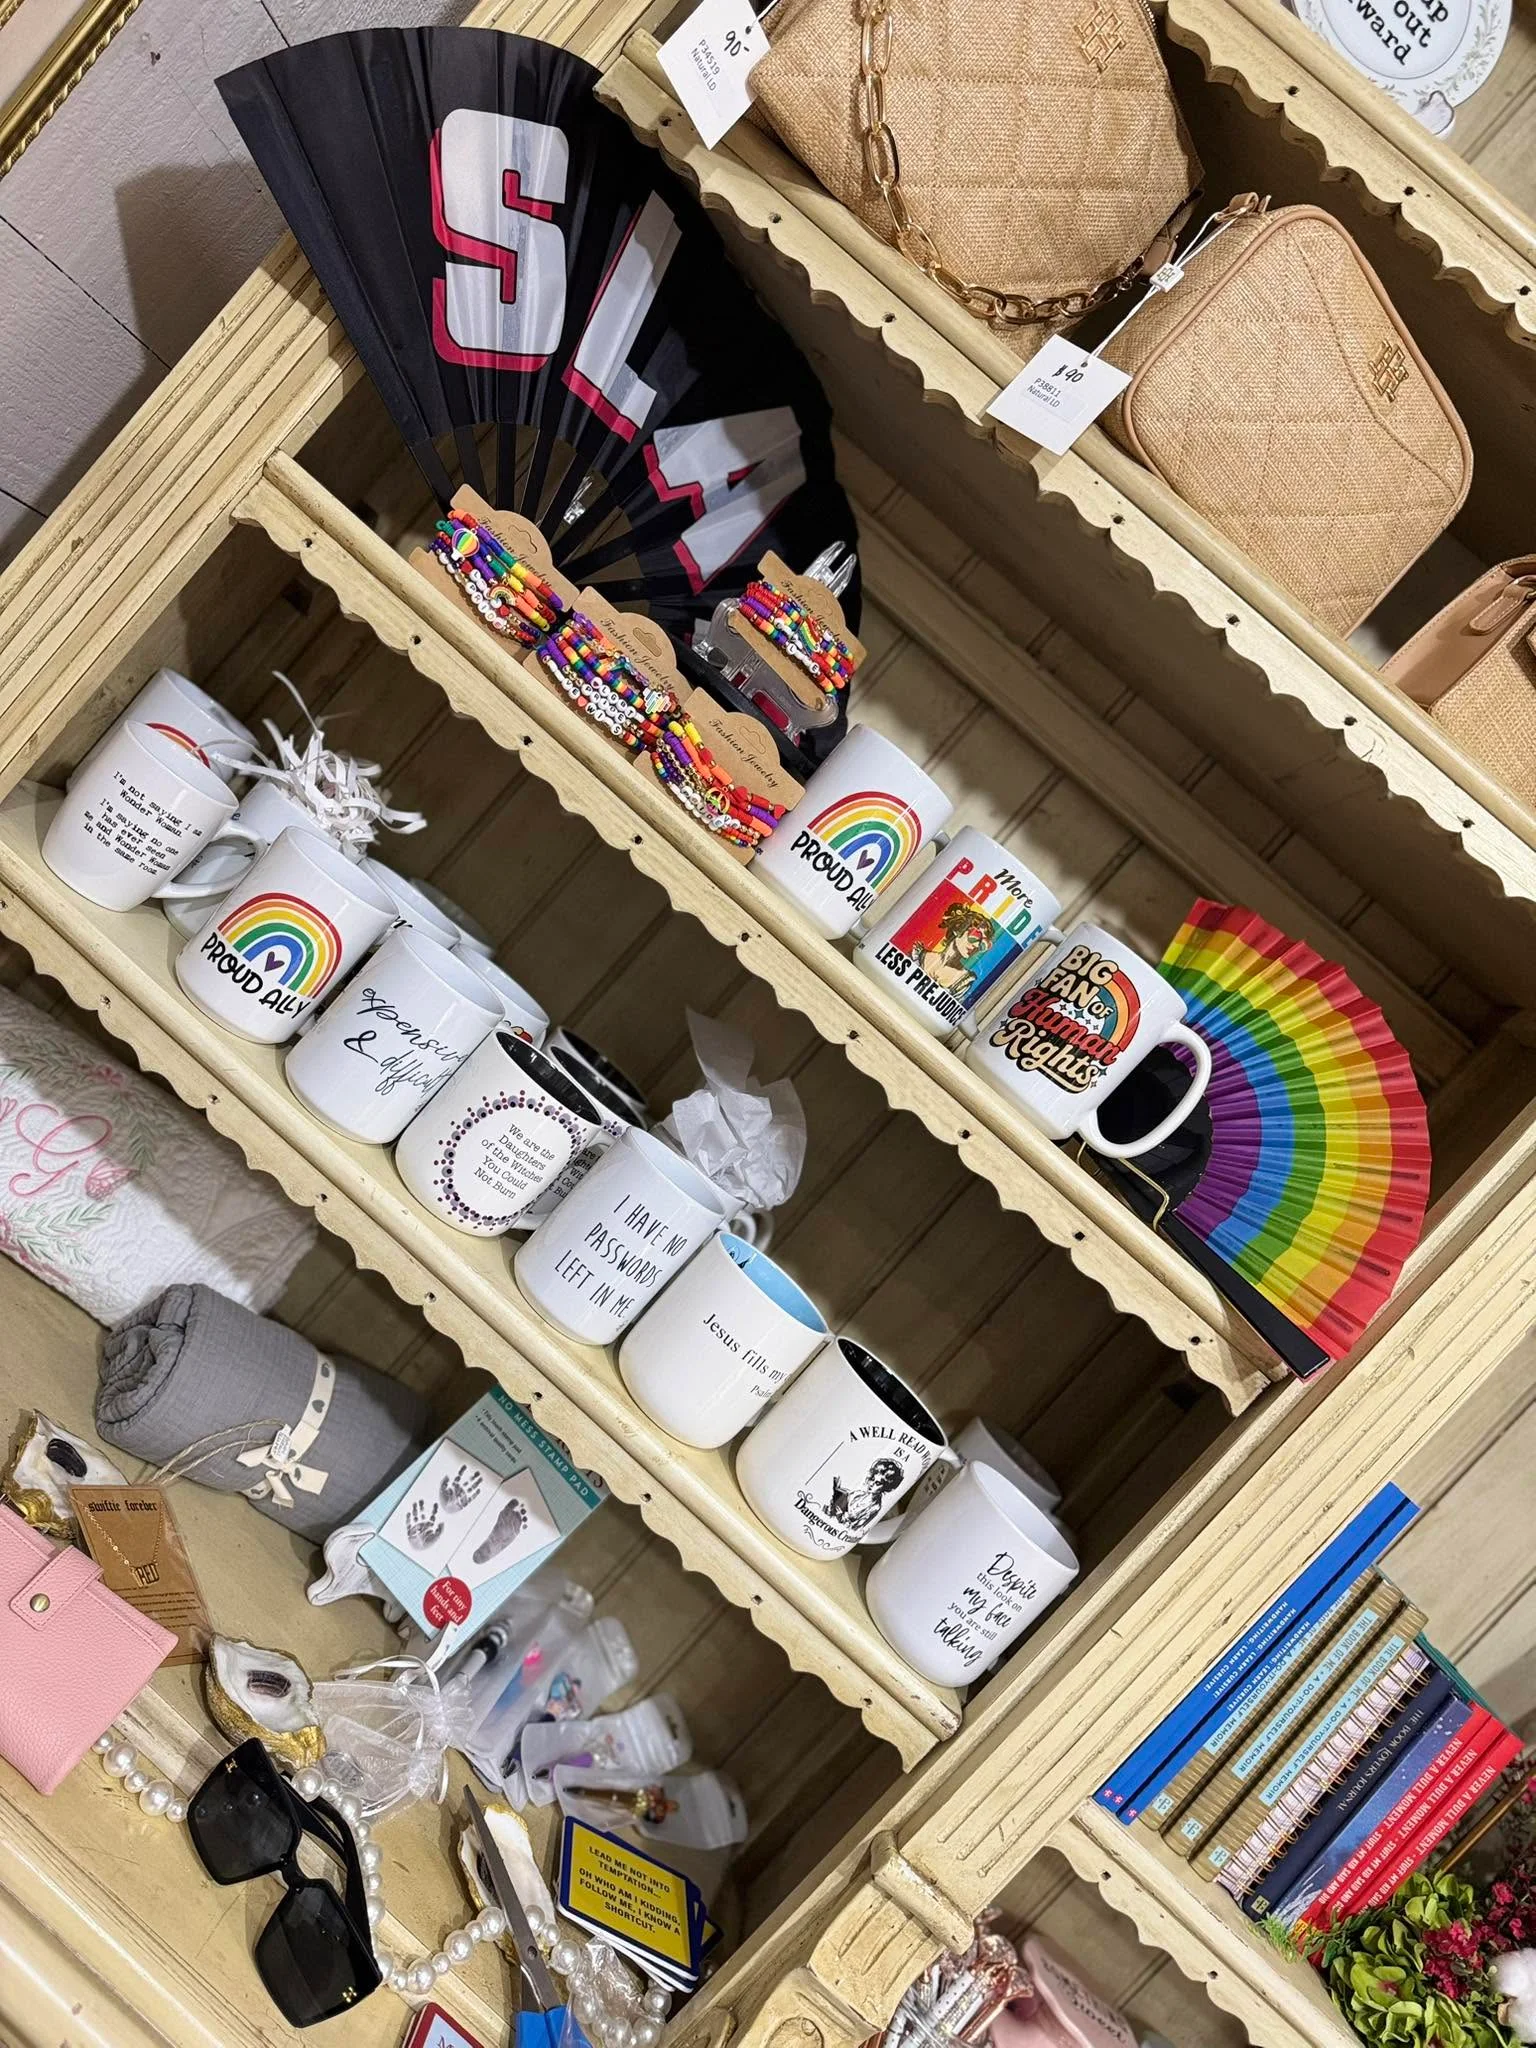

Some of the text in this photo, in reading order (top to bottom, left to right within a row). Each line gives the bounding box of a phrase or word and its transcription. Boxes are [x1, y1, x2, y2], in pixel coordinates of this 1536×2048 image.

[1351, 0, 1412, 66] ward
[1393, 1, 1431, 48] out
[691, 47, 717, 91] Natural LD
[699, 39, 720, 75] P34519
[428, 108, 806, 595] SLA
[1027, 385, 1060, 408] Natural LD
[1034, 377, 1062, 397] P38811
[477, 515, 516, 556] Fashion
[781, 580, 814, 616] Fashion
[600, 616, 675, 690] Fashion Jewelry
[708, 719, 778, 788] Fashion Jewelry
[100, 798, 150, 839] I'm saying
[113, 771, 183, 827] I'm not saying
[119, 789, 154, 817] Wonder
[84, 822, 136, 864] in the same
[96, 820, 147, 858] and Wonder
[101, 812, 166, 860] has ever seen
[790, 829, 853, 894] PROUD
[945, 856, 1042, 950] PRIDE
[995, 867, 1033, 909] More
[200, 931, 311, 1019] PROUD ALLY
[875, 941, 968, 1027] LESS PREJUDICE
[1061, 944, 1118, 986] BIG
[1041, 969, 1101, 1010] FAN
[1008, 988, 1118, 1066] Human
[343, 1030, 379, 1064] &
[989, 1021, 1101, 1095] Rights
[481, 1137, 544, 1184] of the Witches
[498, 1134, 547, 1171] Daughters
[508, 1123, 556, 1161] We are the
[473, 1166, 518, 1200] Not Burn
[481, 1154, 529, 1191] You Could
[612, 1194, 687, 1258] I HAVE NO
[584, 1222, 664, 1289] PASSWORDS
[554, 1249, 596, 1290] LEFT
[589, 1281, 611, 1308] IN
[702, 1313, 770, 1376] Jesus fills
[498, 1394, 513, 1411] NO
[512, 1409, 538, 1438] MESS
[538, 1436, 570, 1474] STAMP
[566, 1471, 591, 1498] PAD
[848, 1425, 927, 1459] A WELL READ
[88, 1500, 121, 1512] swiftie
[793, 1497, 841, 1538] Dangerous
[442, 1580, 467, 1611] For tiny
[976, 1572, 1013, 1605] this look
[985, 1551, 1038, 1601] Despite
[430, 1585, 463, 1623] hands and
[430, 1604, 444, 1621] feet
[948, 1601, 998, 1642] you are still
[963, 1585, 1013, 1628] my face
[932, 1616, 985, 1668] talking
[1202, 1600, 1288, 1692] HANDWRITING: LEARN CURSIVE!
[1211, 1607, 1296, 1699] HANDWRITING: LEARN CURSIVE!
[1225, 1618, 1310, 1713] HANDWRITING: LEARN CURSIVE!
[1209, 1658, 1287, 1748] DO-IT-YOURSELF MEMOIR
[1237, 1615, 1372, 1772] THE BOOK DO-IT-YOURSELF MEMOIR
[1264, 1641, 1399, 1799] THE BOOK OF DO-IT-YOURSELF MEMOIR
[1387, 1723, 1411, 1749] BOOK
[1407, 1707, 1425, 1726] THE
[1427, 1763, 1440, 1775] A
[1434, 1736, 1463, 1767] NEVER
[1449, 1748, 1478, 1778] NEVER
[1334, 1775, 1368, 1813] JOURNAL
[1409, 1769, 1434, 1795] DULL
[1425, 1781, 1448, 1805] DULL
[1442, 1773, 1455, 1786] A
[1380, 1790, 1417, 1829] MOMENT
[1394, 1800, 1431, 1839] MOMENT
[1354, 1847, 1368, 1861] MY
[1363, 1830, 1383, 1851] STUFF
[1377, 1839, 1397, 1860] STUFF
[588, 1846, 670, 1893] LEAD ME NOT INTO
[1335, 1866, 1351, 1883] SAID
[1346, 1856, 1360, 1871] KID
[1359, 1865, 1374, 1879] KID
[1368, 1856, 1382, 1869] MY
[578, 1867, 592, 1879] OH
[594, 1875, 616, 1891] WHO
[618, 1887, 633, 1901] AM
[1324, 1879, 1341, 1896] AND
[1337, 1887, 1354, 1904] AND
[1348, 1874, 1365, 1892] SAID
[579, 1878, 617, 1902] FOLLOW
[643, 1911, 672, 1930] KNOW
[604, 1901, 656, 1934] SHORTCUT.
